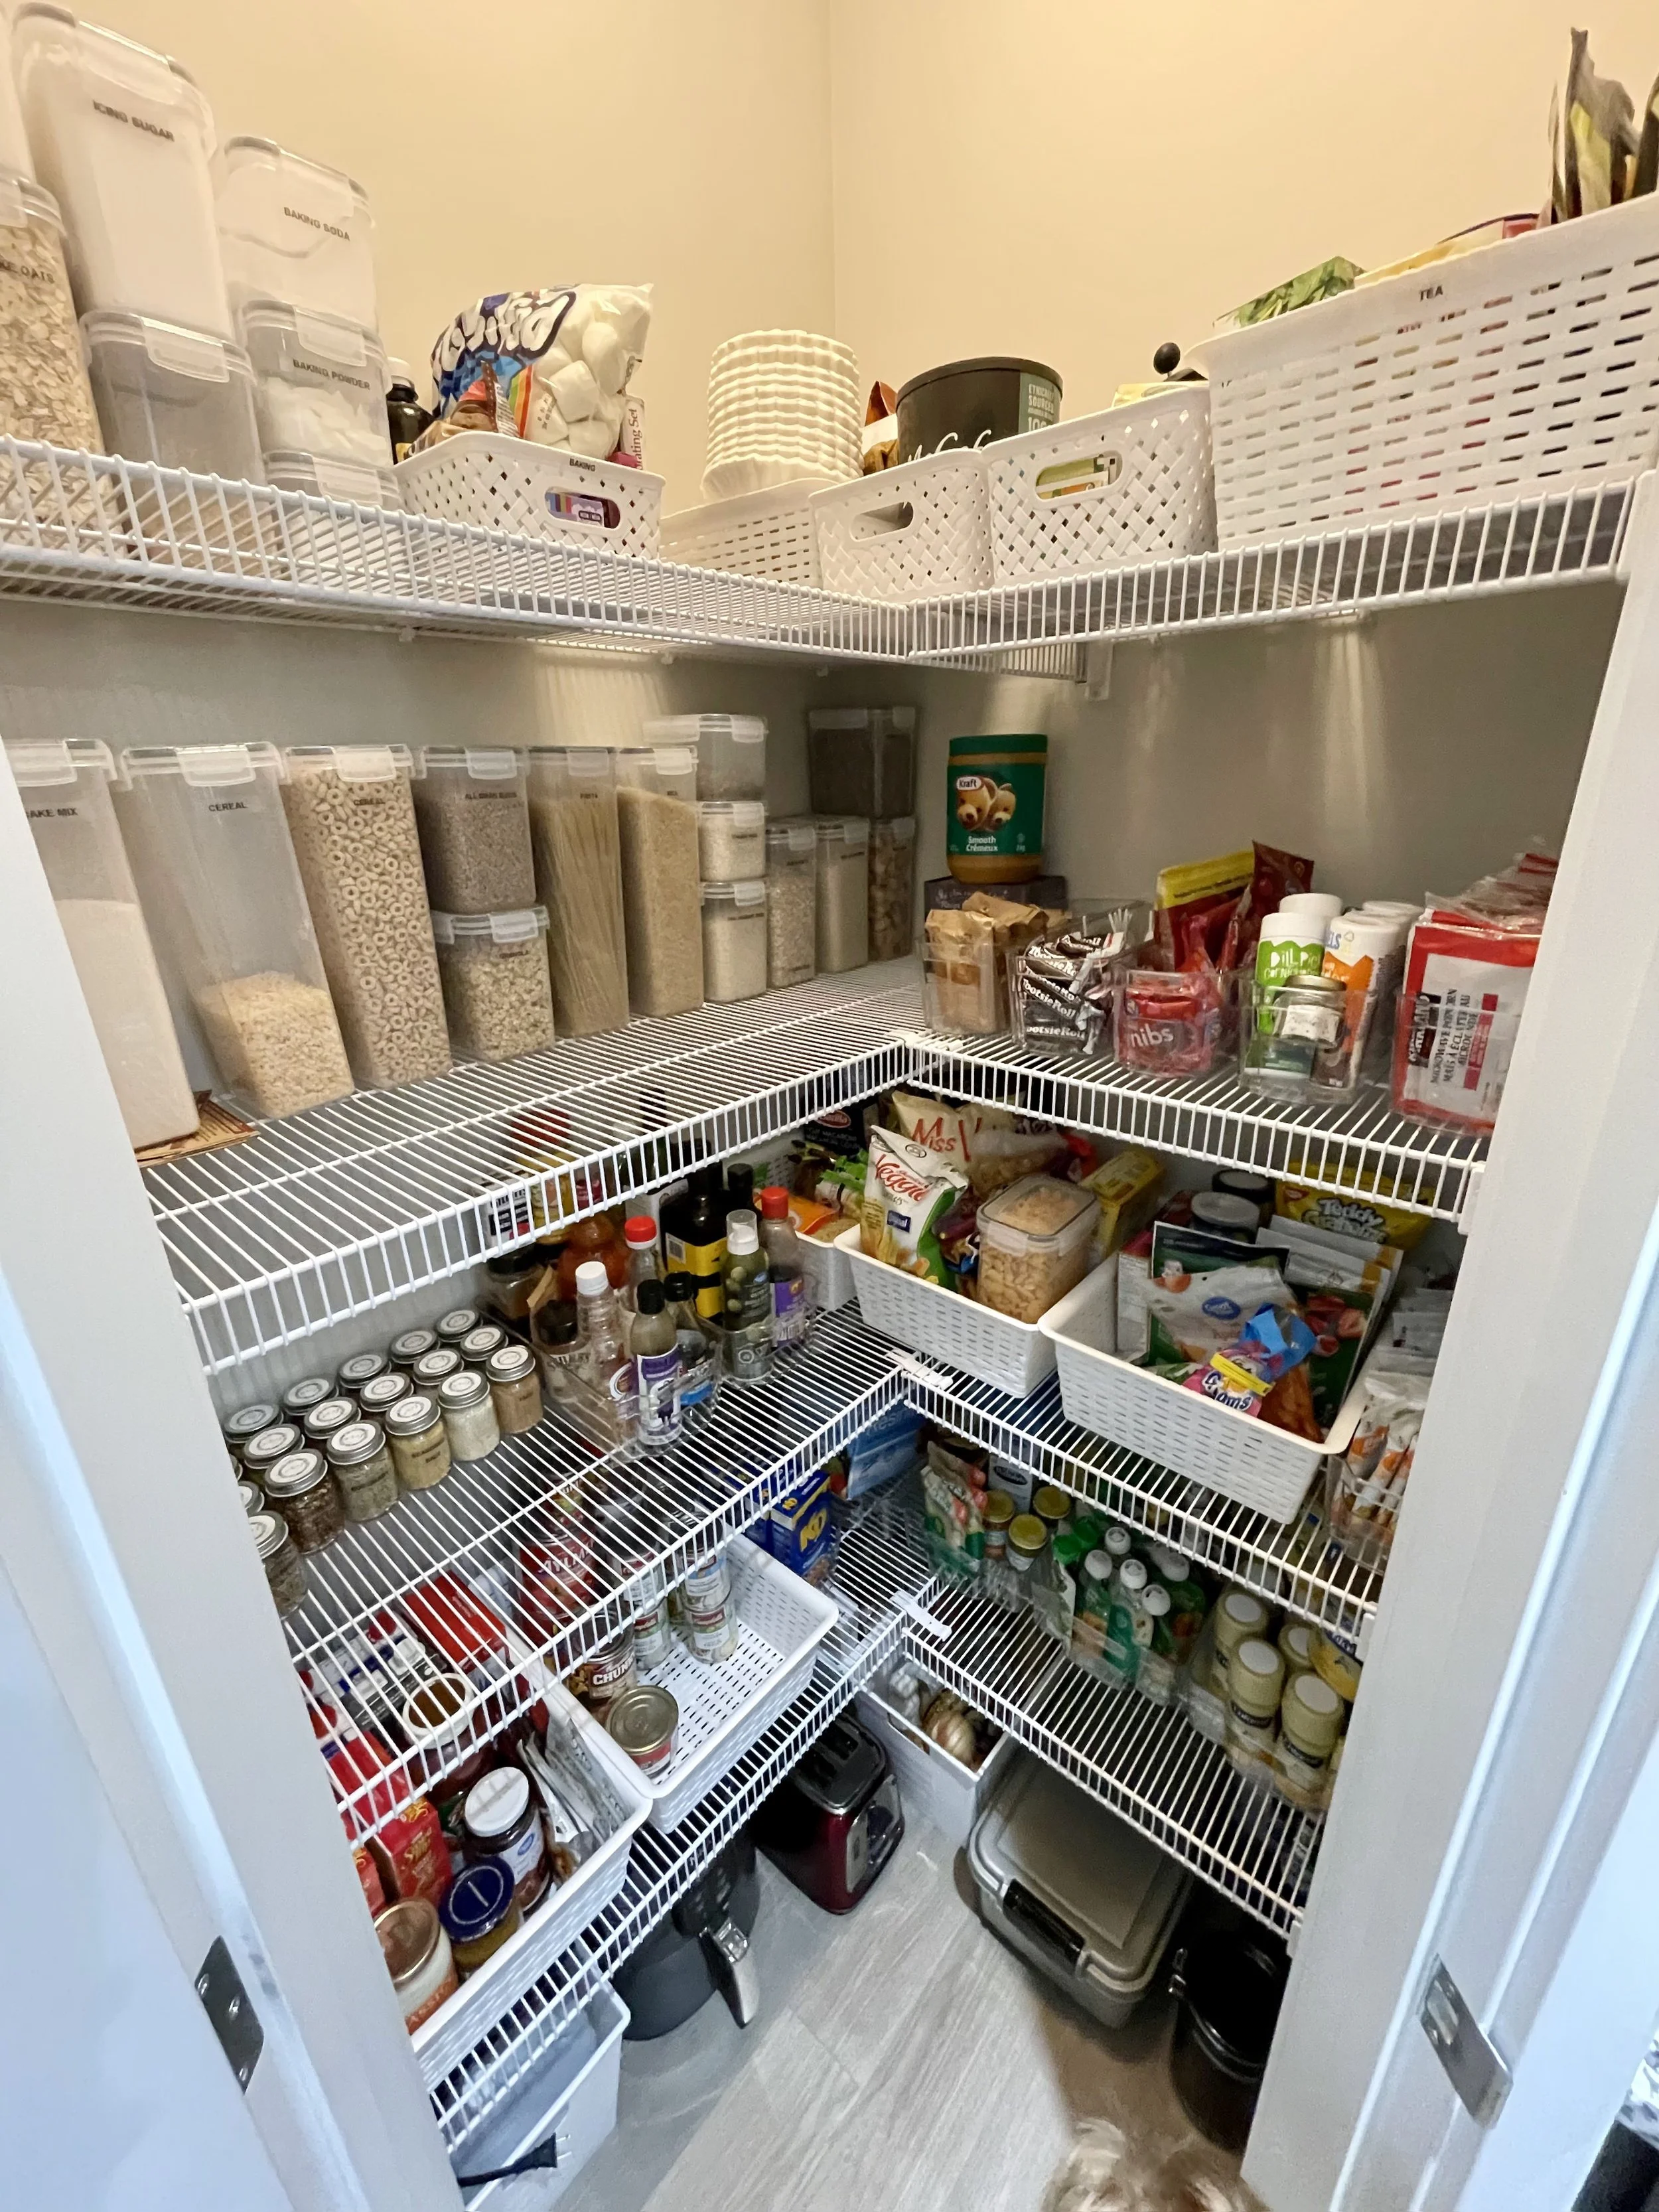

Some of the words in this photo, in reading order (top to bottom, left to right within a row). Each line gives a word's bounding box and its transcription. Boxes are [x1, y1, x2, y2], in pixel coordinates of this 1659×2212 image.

[93, 100, 128, 123] ICING
[131, 117, 175, 142] SUGAR
[283, 206, 321, 229] BAKING
[323, 223, 350, 242] SODA
[1419, 285, 1443, 303] TEA
[292, 358, 330, 378] BAKING
[331, 371, 371, 390] POWDER
[569, 458, 596, 472] BAKING
[958, 778, 977, 788] Kraft
[208, 802, 249, 812] CEREAL
[353, 797, 386, 806] CEREAL
[26, 809, 56, 818] AKE
[56, 808, 78, 816] MIX
[968, 836, 997, 844] Smooth
[1130, 1023, 1174, 1049] nibs
[912, 1117, 957, 1153] Miss
[1317, 1198, 1386, 1228] Teddy
[592, 1653, 635, 1686] CHUN
